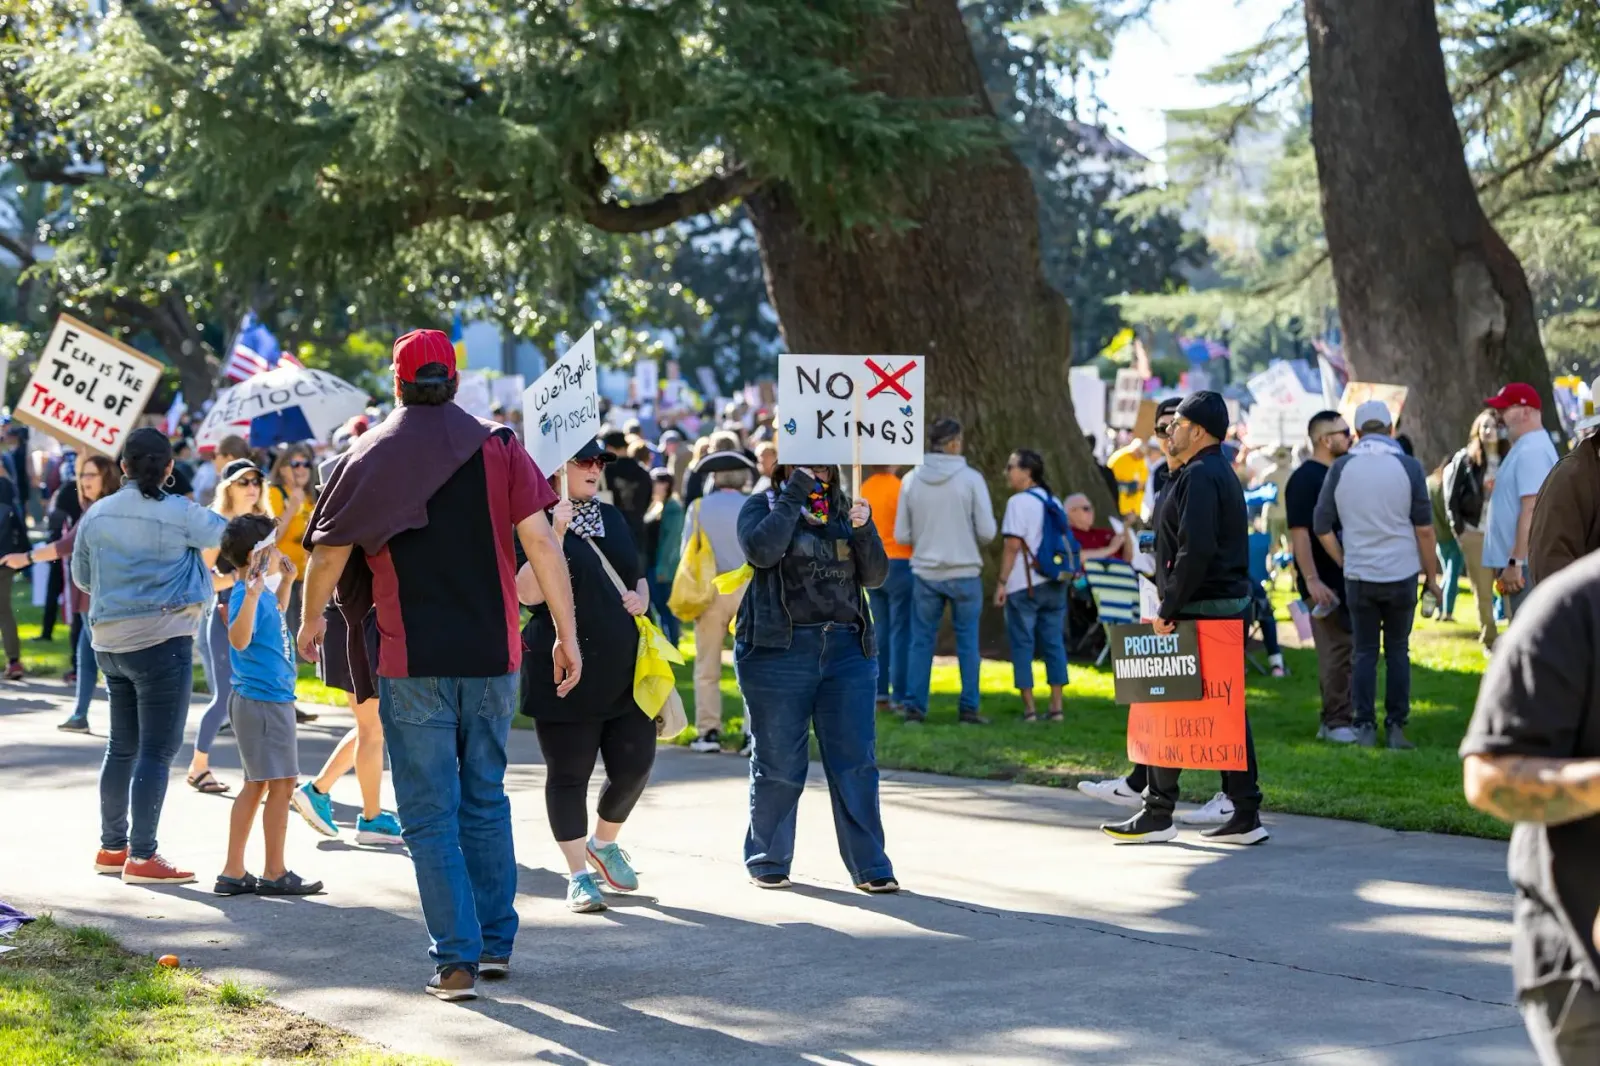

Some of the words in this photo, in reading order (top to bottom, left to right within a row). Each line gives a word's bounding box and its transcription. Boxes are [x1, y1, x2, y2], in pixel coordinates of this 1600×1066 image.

[796, 365, 854, 400] NO
[103, 394, 133, 416] OF
[534, 385, 560, 411] We
[30, 382, 120, 445] TYRANTS
[1124, 633, 1179, 656] PROTECT
[1115, 654, 1197, 679] IMMIGRANTS
[1164, 715, 1214, 738] LIBERTY
[1190, 744, 1230, 764] EXIST
